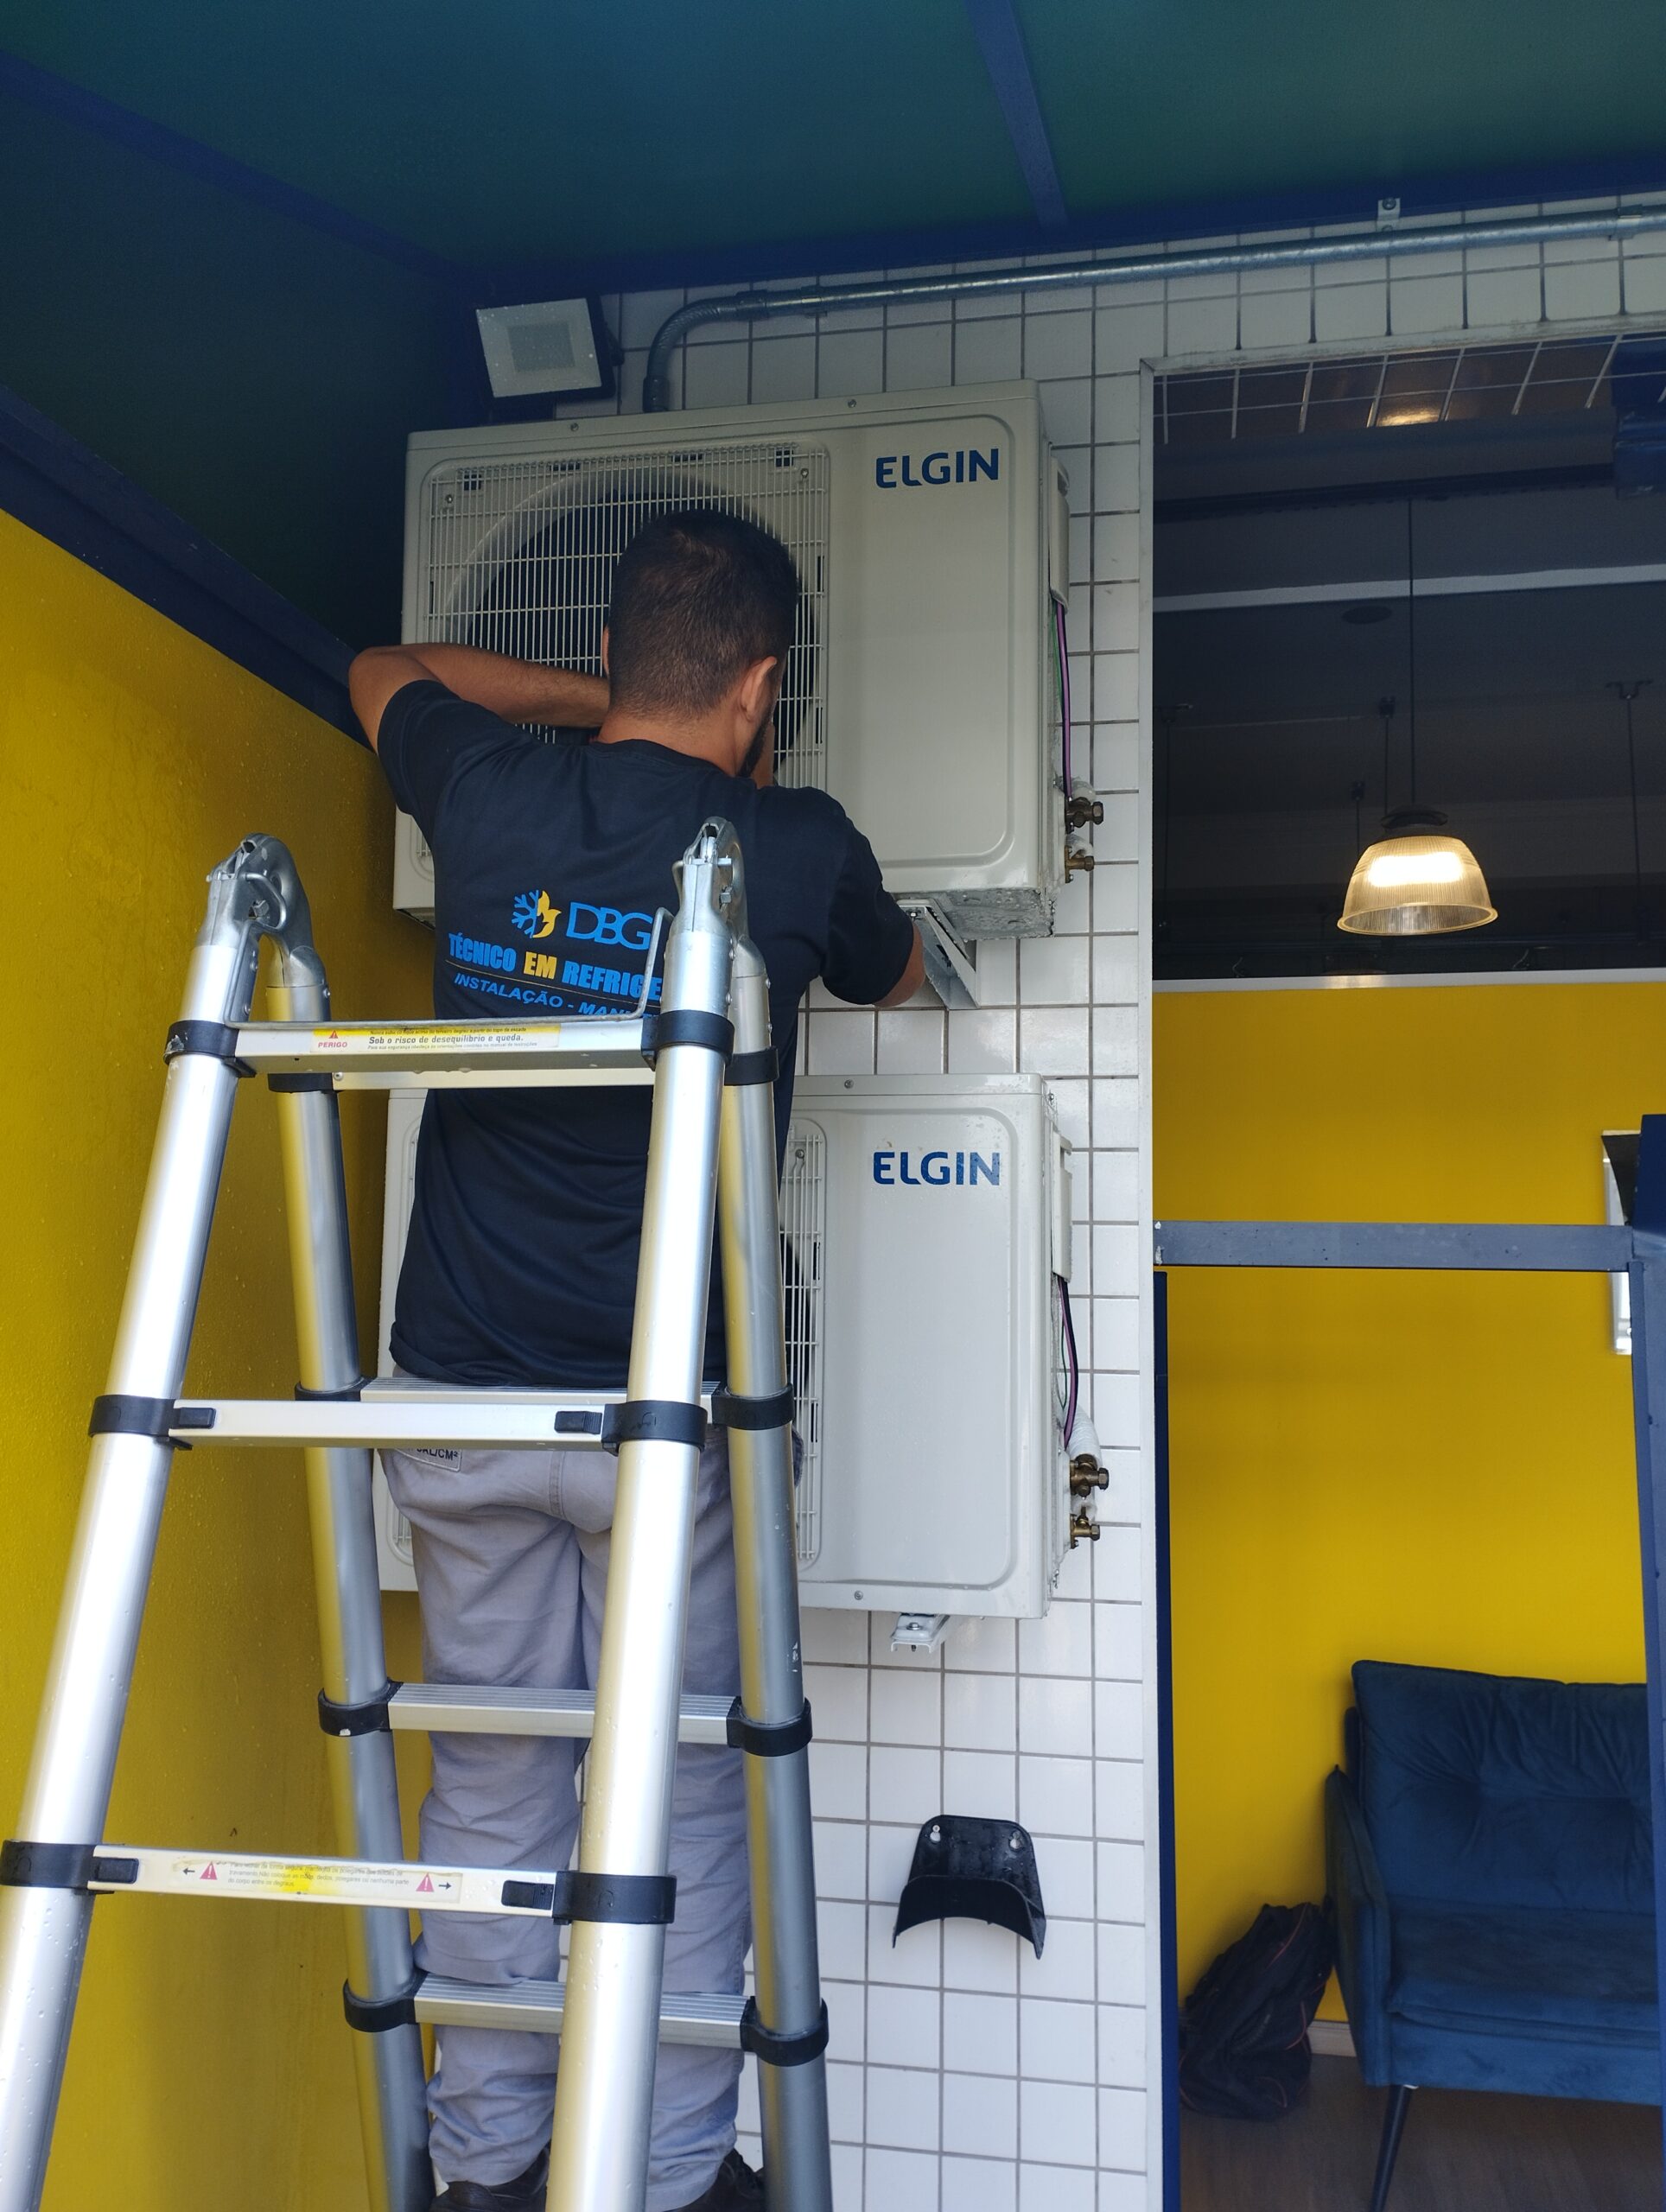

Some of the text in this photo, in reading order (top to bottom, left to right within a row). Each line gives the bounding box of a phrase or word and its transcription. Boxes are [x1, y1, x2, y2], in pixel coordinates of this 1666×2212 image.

[876, 448, 999, 489] ELGIN
[565, 901, 653, 950] DBG
[448, 931, 518, 973] TÉCNICO
[523, 950, 558, 980] EM
[453, 972, 563, 1008] INSTALAÇÃO
[369, 1036, 385, 1045] Sob
[418, 1035, 429, 1044] de
[496, 1033, 524, 1043] queda.
[873, 1151, 1001, 1186] ELGIN
